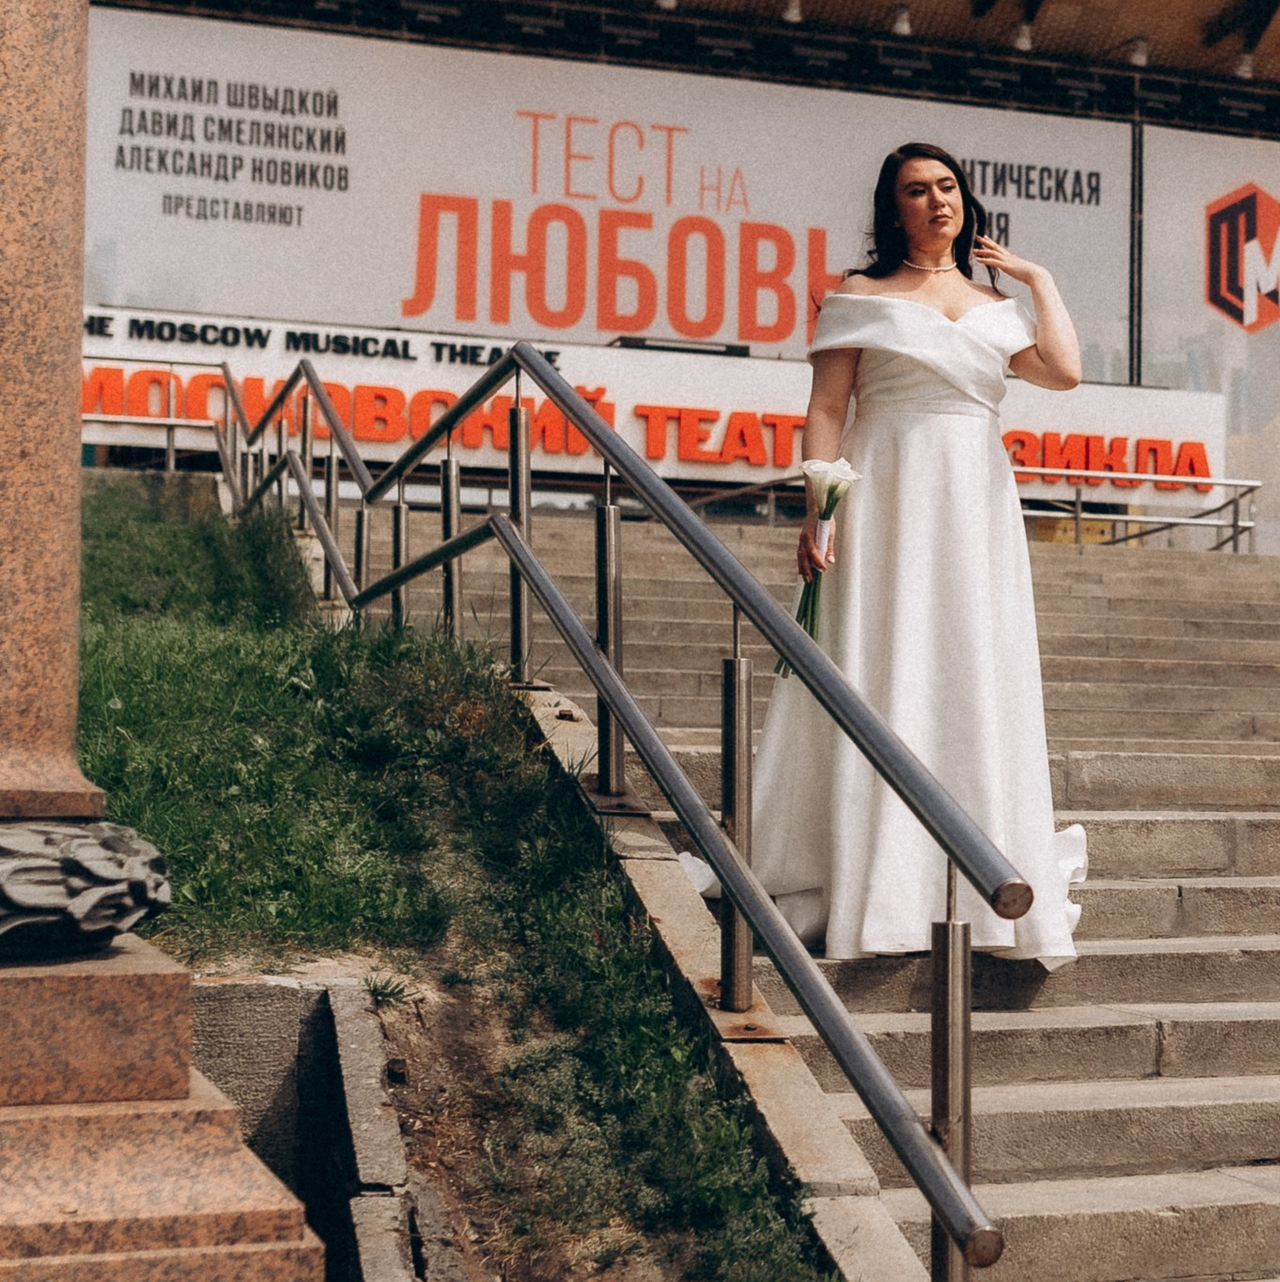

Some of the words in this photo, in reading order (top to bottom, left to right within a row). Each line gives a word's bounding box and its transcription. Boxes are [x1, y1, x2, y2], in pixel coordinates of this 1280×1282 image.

[129, 71, 219, 105] МИХАИЛ
[226, 82, 338, 117] ШВЫДКОЙ
[119, 107, 196, 142] ДАВИД
[203, 114, 346, 155] СМЕЛЯНСКИЙ
[114, 144, 244, 182] АЛЕКСАНДР
[251, 157, 349, 192] НОВИКОВ
[515, 109, 689, 205] ТЕСТ
[699, 163, 751, 215] НА
[162, 194, 304, 227] ПРЕДСТАВЛЯЮТ
[128, 318, 271, 348] MOSCOW
[285, 331, 417, 362] MUSICAL
[430, 341, 561, 372] THEAE
